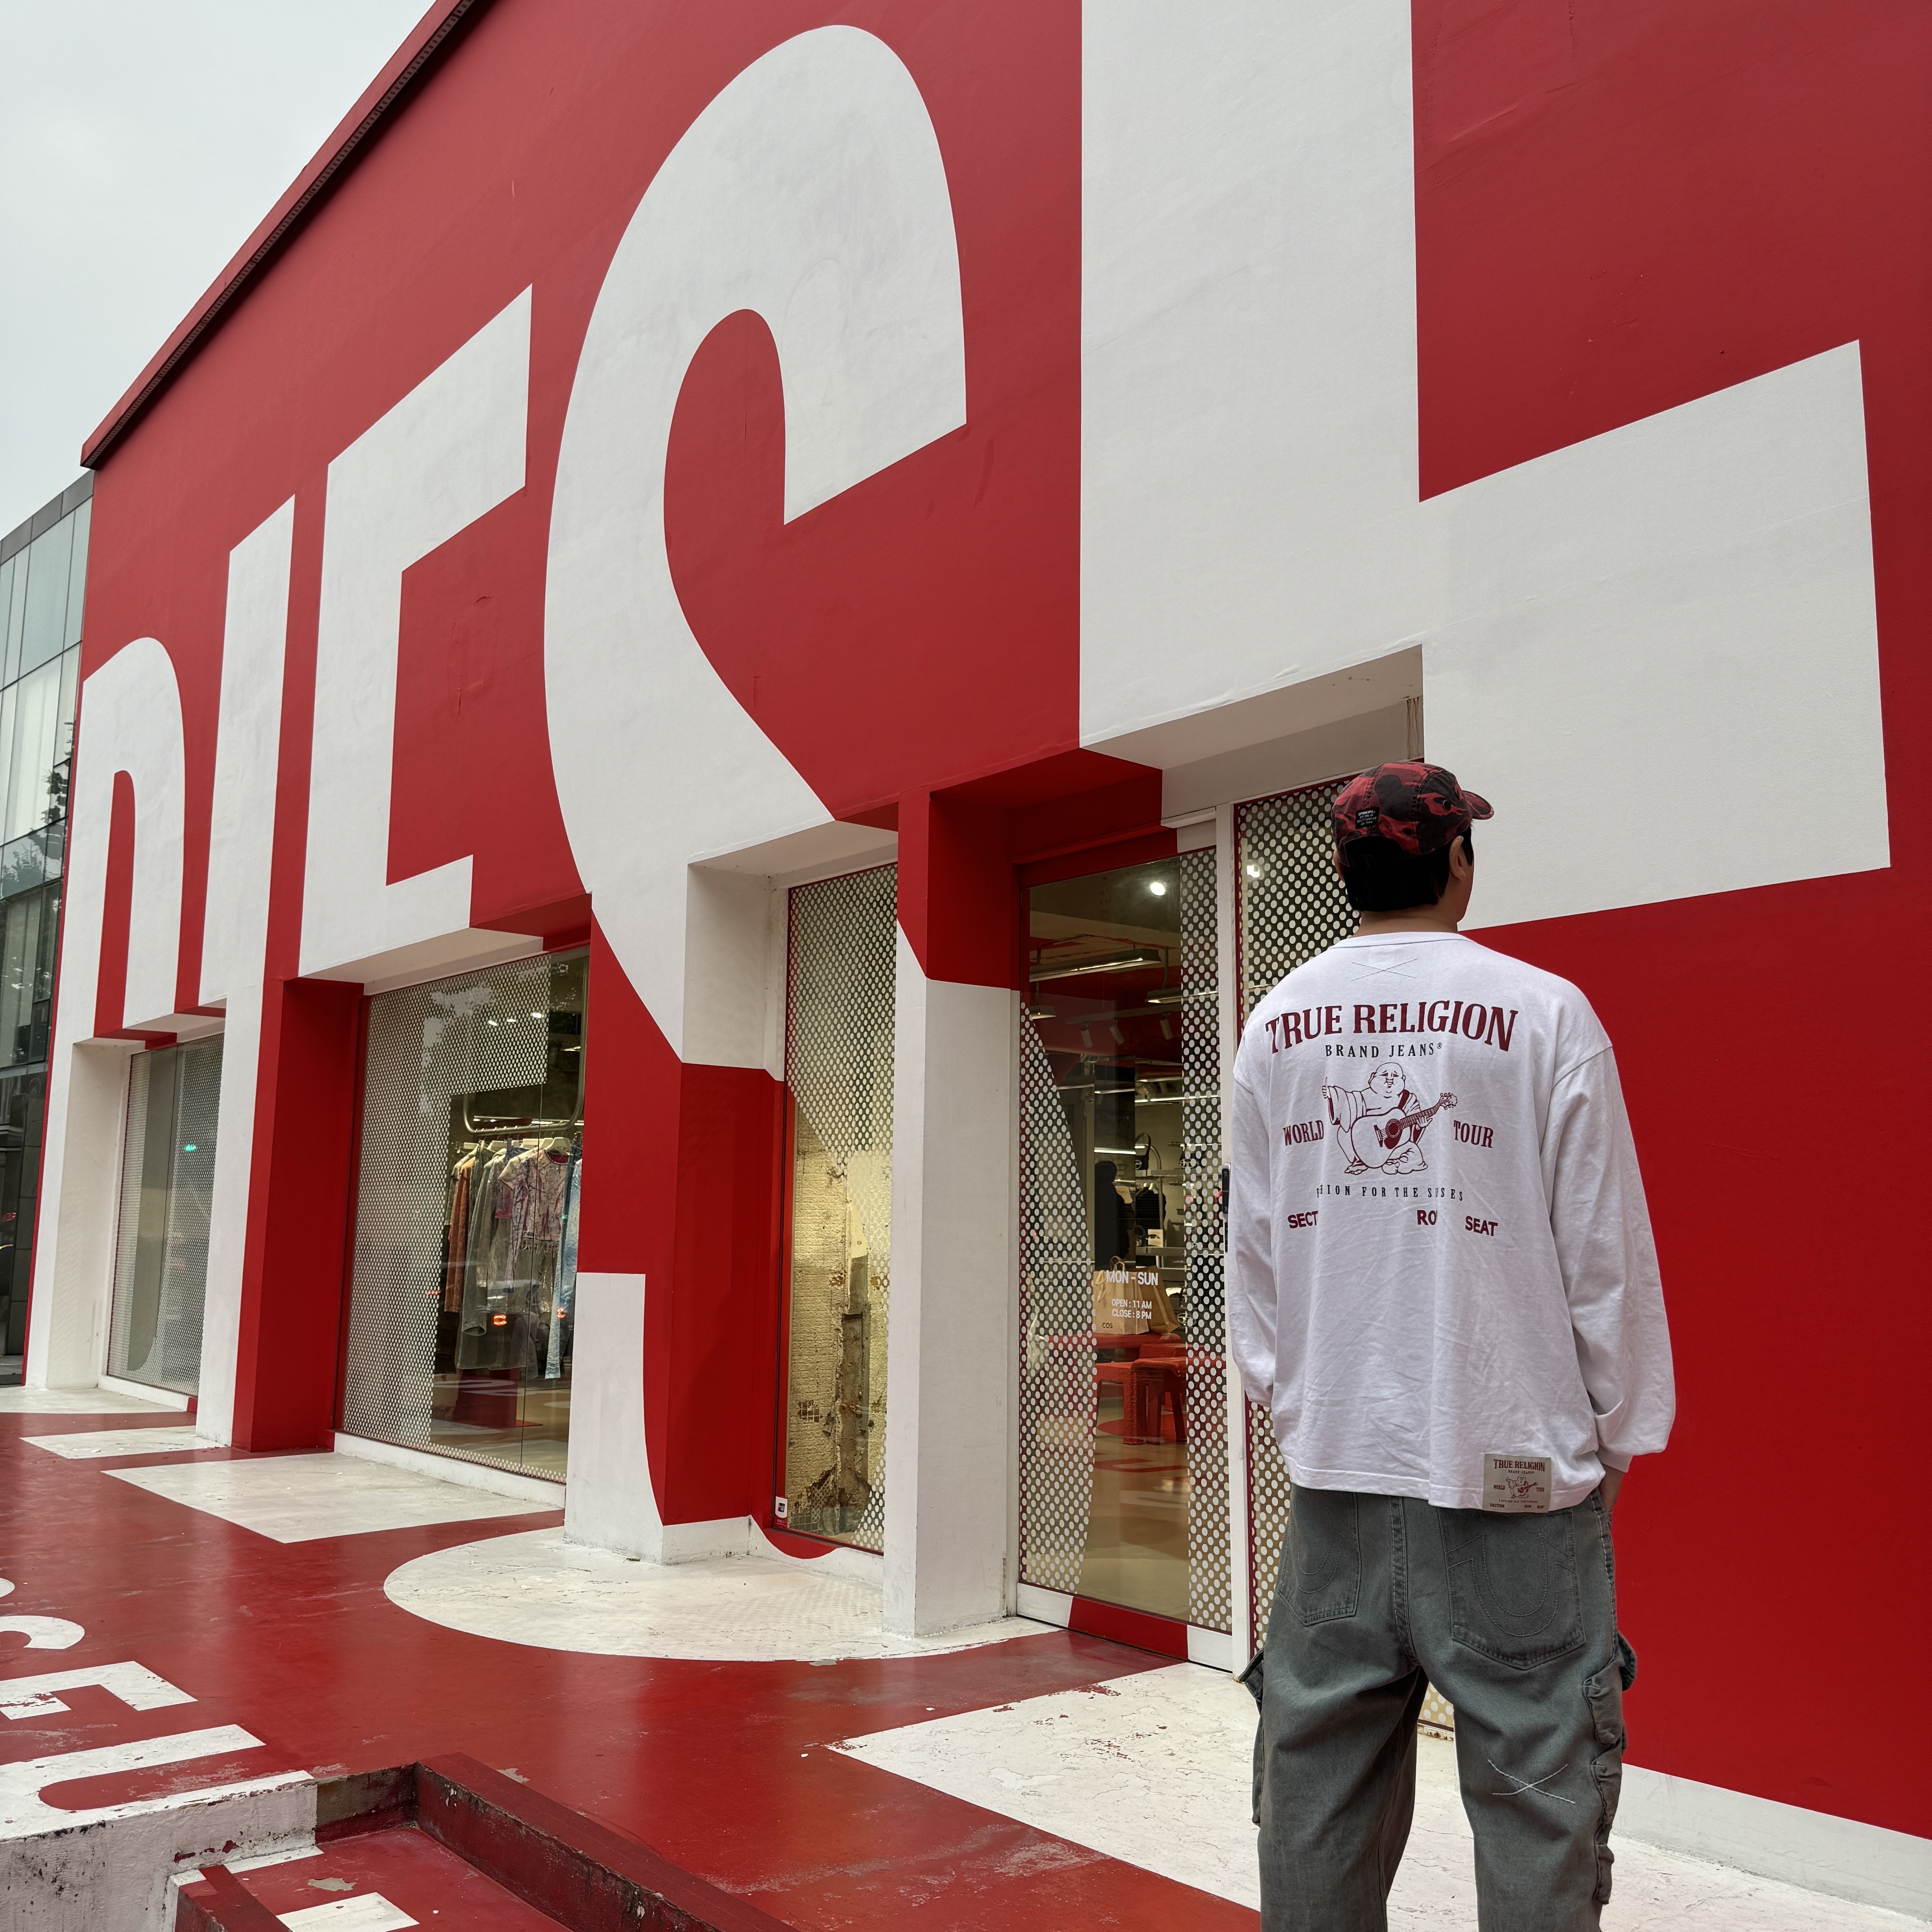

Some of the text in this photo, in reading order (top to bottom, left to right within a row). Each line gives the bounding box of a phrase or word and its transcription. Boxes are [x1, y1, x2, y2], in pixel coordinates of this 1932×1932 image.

[1265, 1000, 1518, 1054] TRUE RELIGION
[1325, 1044, 1379, 1058] BRAND
[1283, 1119, 1494, 1148] WORLD TOUR
[1362, 1186, 1386, 1197] FOR
[1394, 1187, 1418, 1197] THE
[1465, 1215, 1498, 1236] SEAT
[1106, 1270, 1129, 1283] MON
[1137, 1272, 1158, 1285] SUN
[1112, 1298, 1127, 1307] OPEN
[1141, 1301, 1152, 1309] AM
[1112, 1309, 1132, 1318] CLOSE
[1141, 1311, 1152, 1320] PM
[1494, 1459, 1545, 1472] TRUE RELIGION
